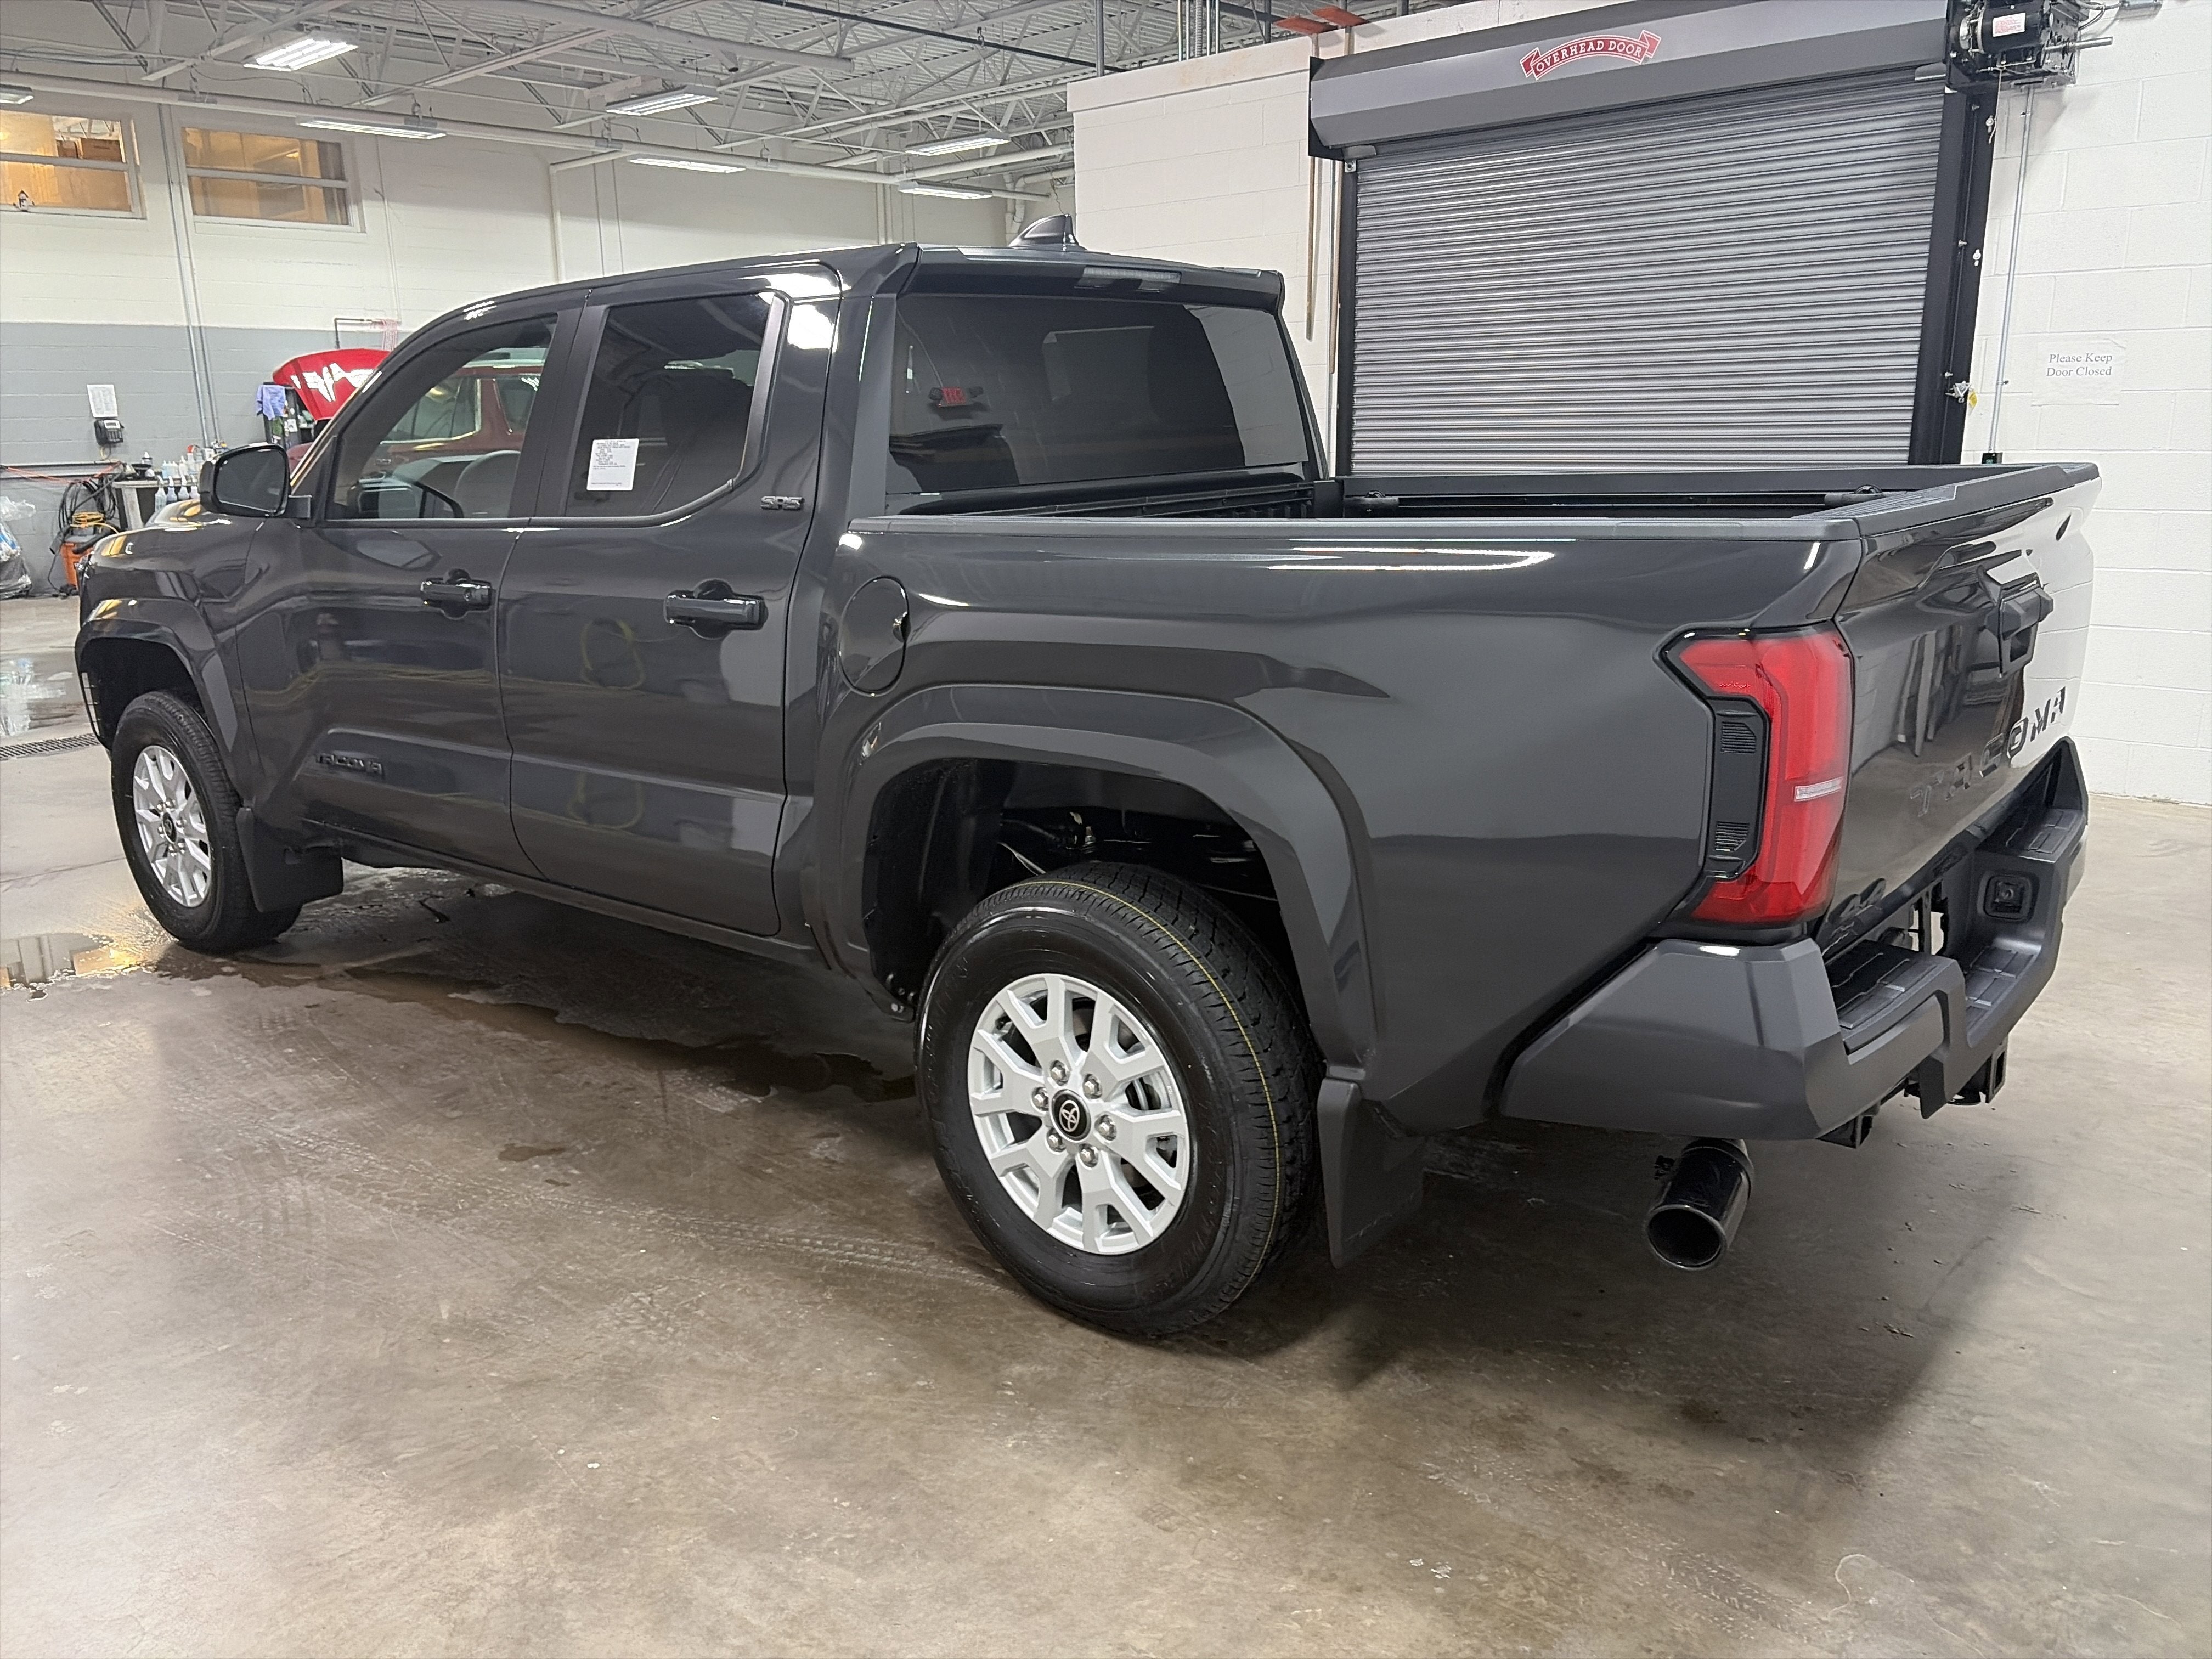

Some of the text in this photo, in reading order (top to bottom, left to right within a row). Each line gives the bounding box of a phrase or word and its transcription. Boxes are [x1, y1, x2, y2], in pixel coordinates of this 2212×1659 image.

[1536, 41, 1642, 72] OVERHEAD DOOR
[2049, 353, 2113, 364] Please Keep
[2046, 366, 2112, 376] Door Closed
[760, 496, 804, 511] SR5
[1910, 686, 2066, 817] TACOMA
